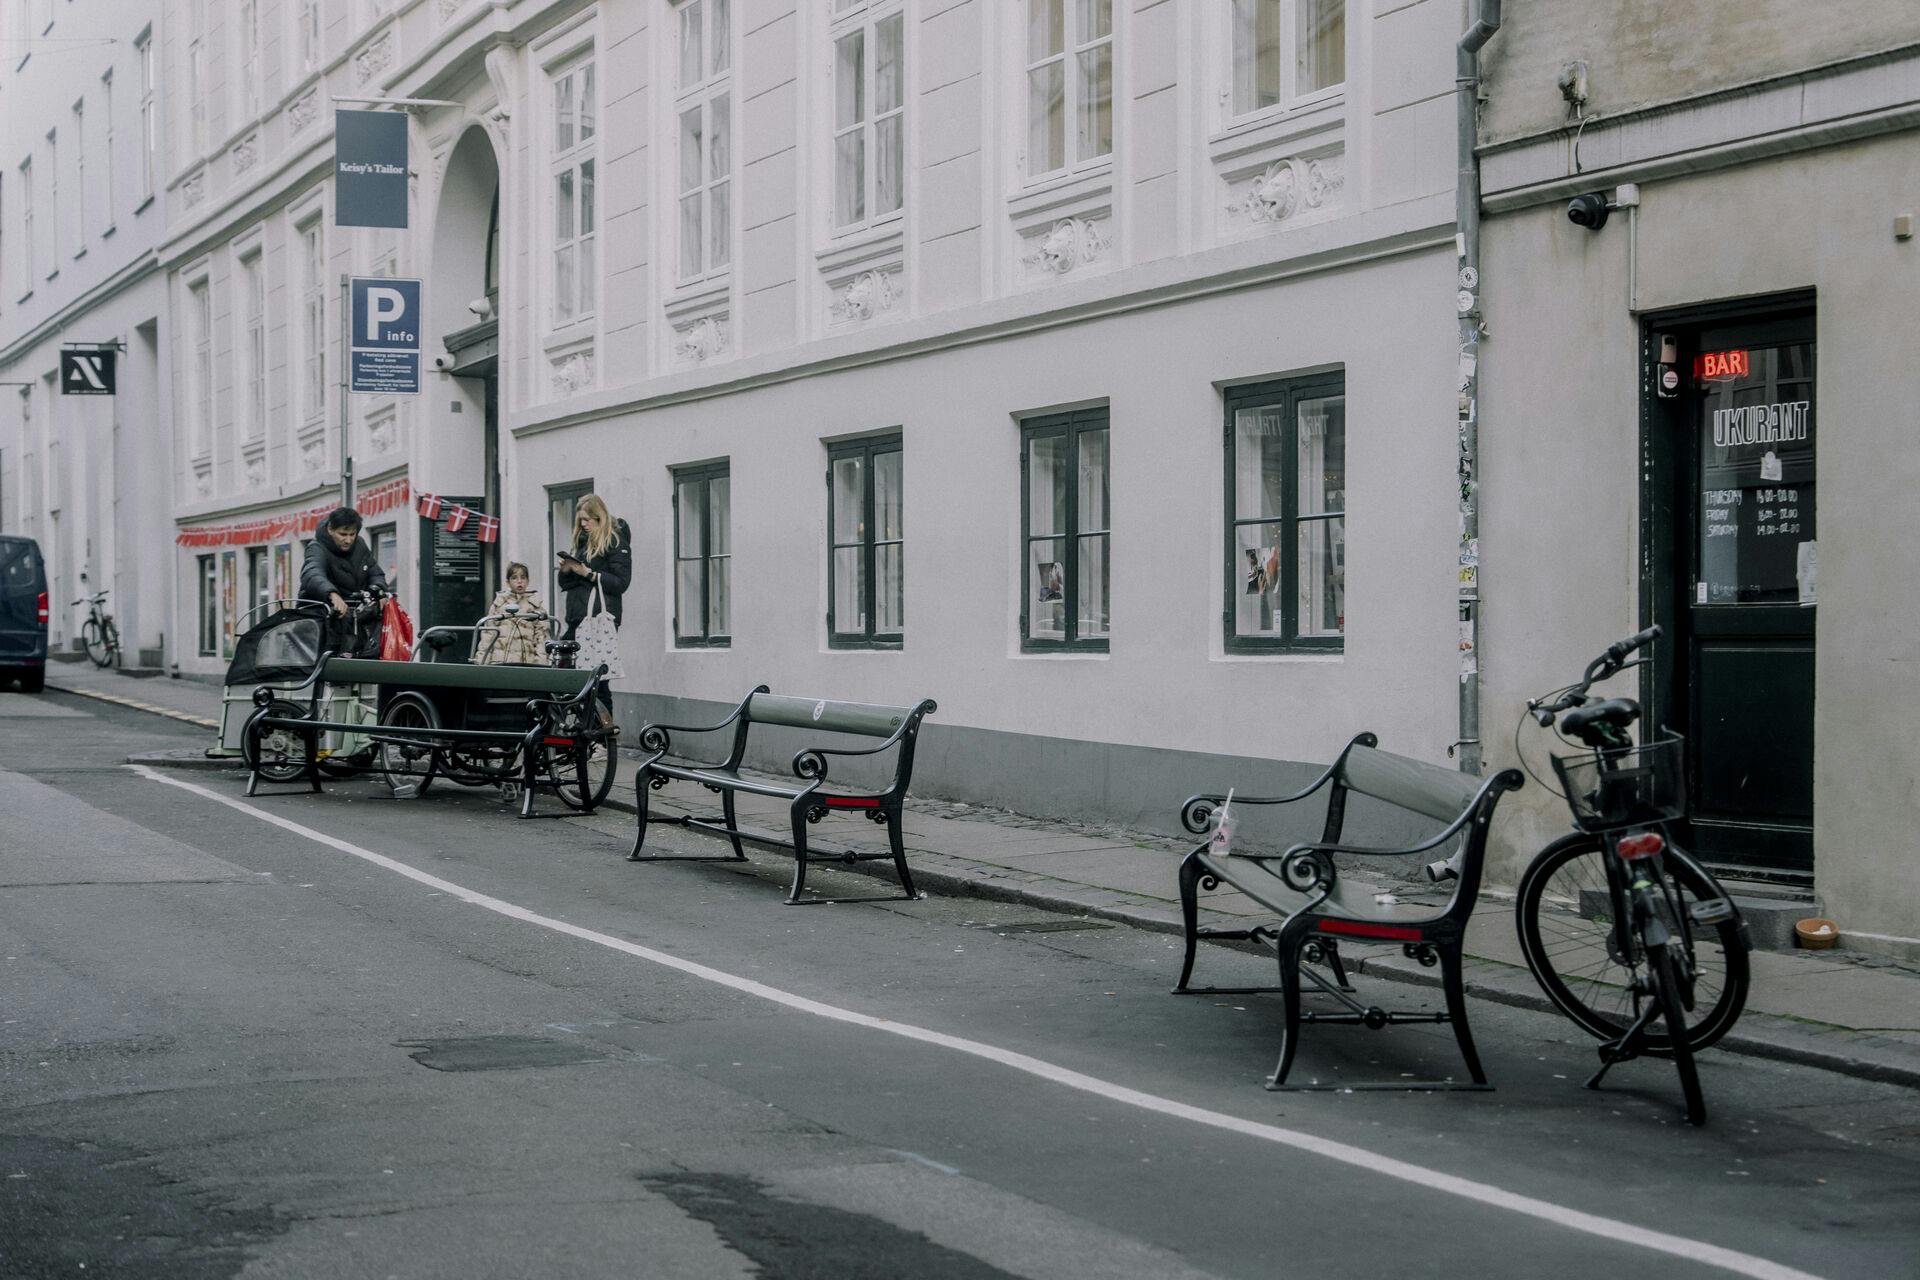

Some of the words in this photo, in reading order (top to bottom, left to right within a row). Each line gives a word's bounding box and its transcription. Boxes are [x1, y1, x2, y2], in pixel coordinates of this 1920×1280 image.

[340, 162, 373, 175] Keisy's
[373, 164, 404, 174] Tailor
[367, 287, 405, 340] P
[387, 330, 414, 341] info
[1704, 350, 1742, 376] BAR
[1713, 401, 1809, 447] UKURANT
